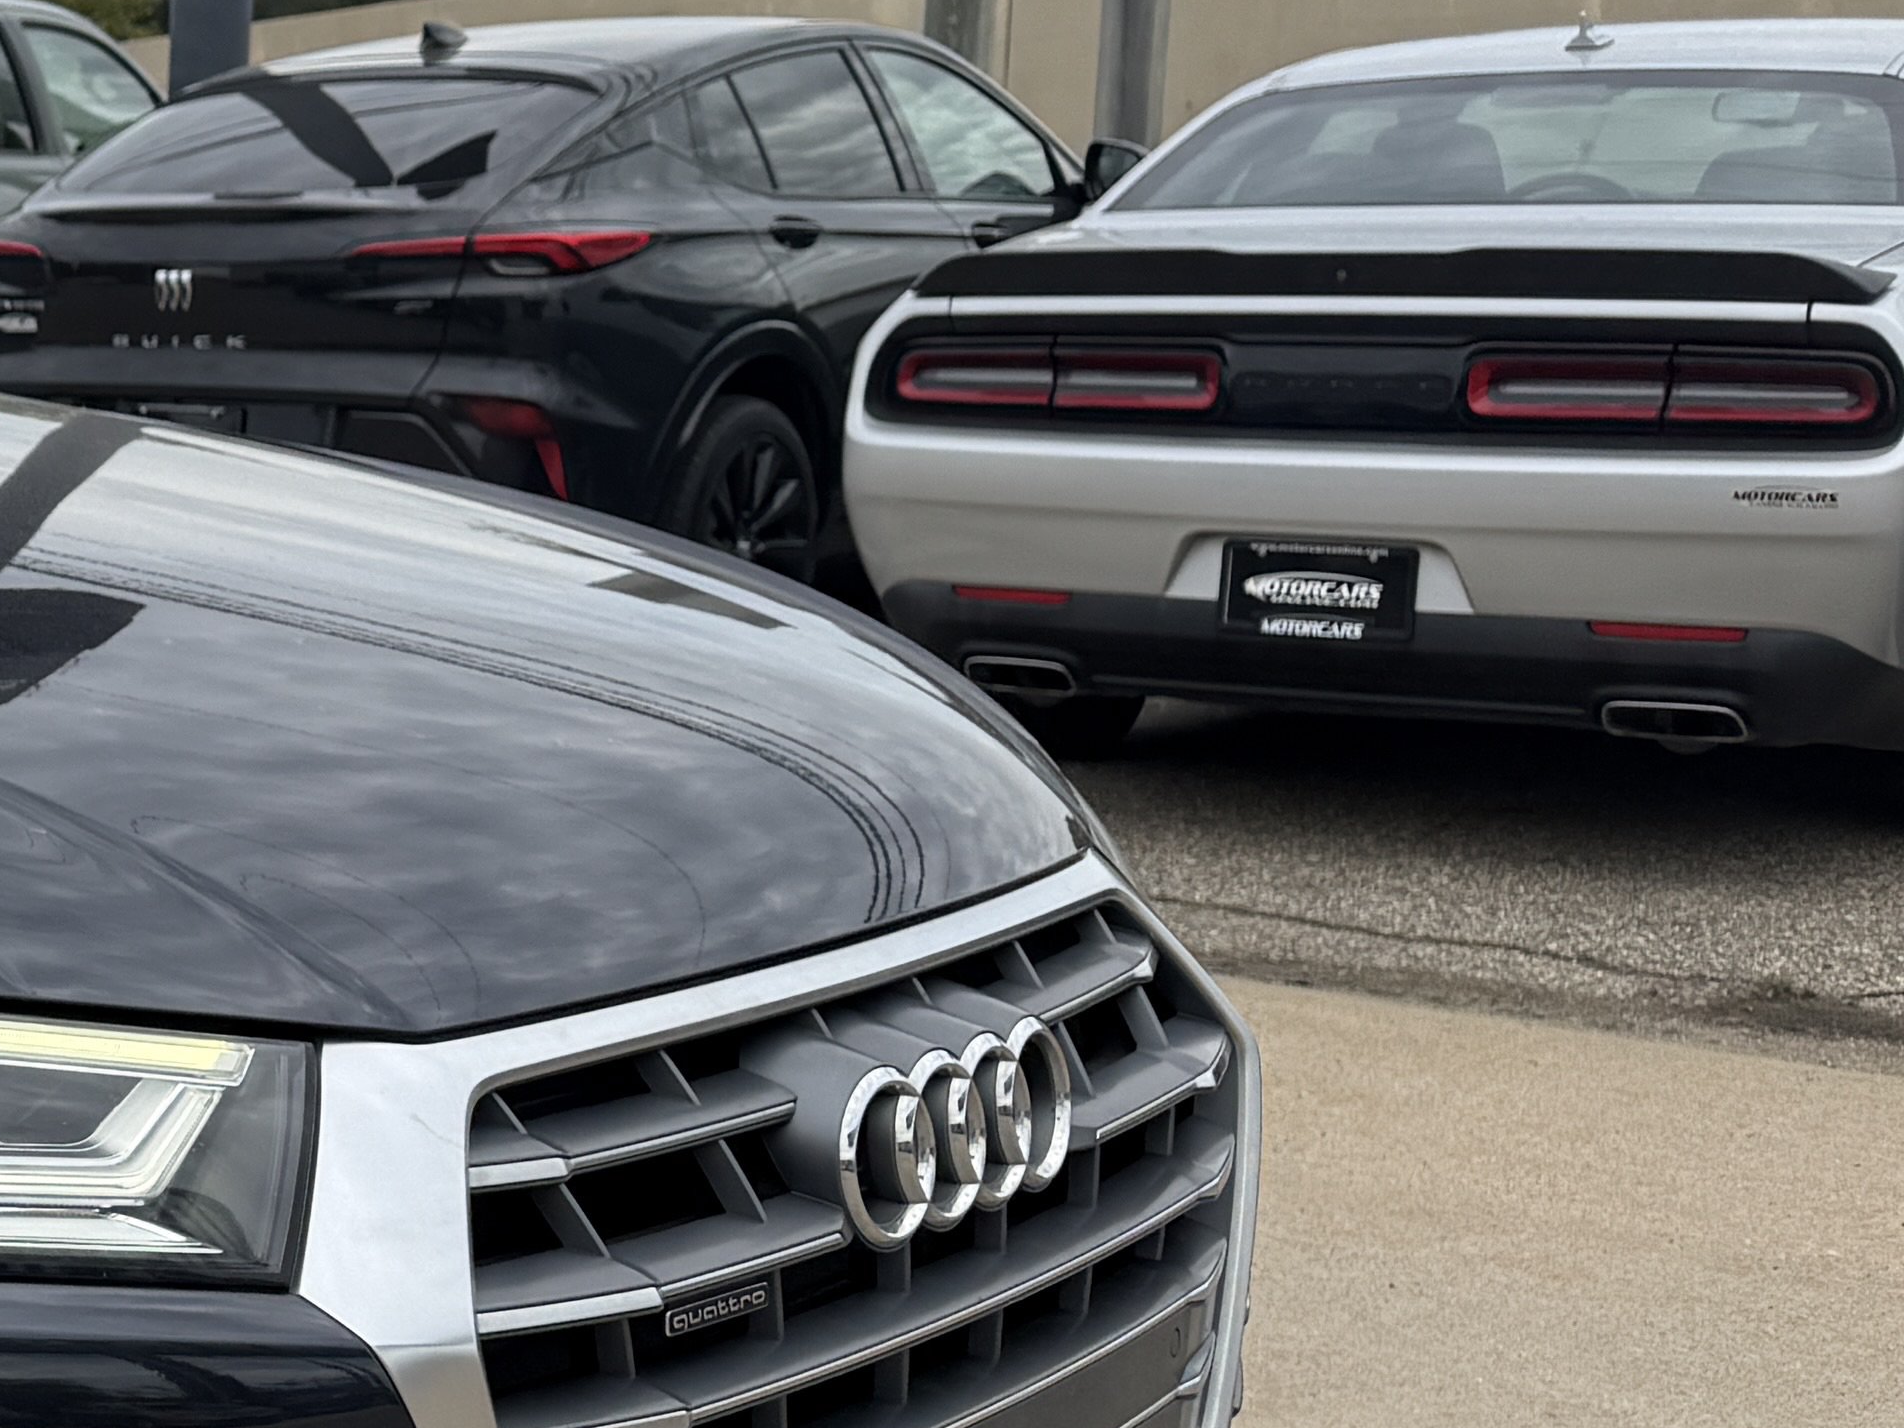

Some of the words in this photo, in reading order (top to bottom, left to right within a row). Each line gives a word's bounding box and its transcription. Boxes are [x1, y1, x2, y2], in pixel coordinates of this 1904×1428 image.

[112, 333, 247, 351] BUICK
[1733, 490, 1839, 502] MOTORCARS
[1244, 576, 1383, 599] MOTORCARS
[1260, 618, 1365, 640] MOTORCARS
[673, 1290, 765, 1331] quattro
